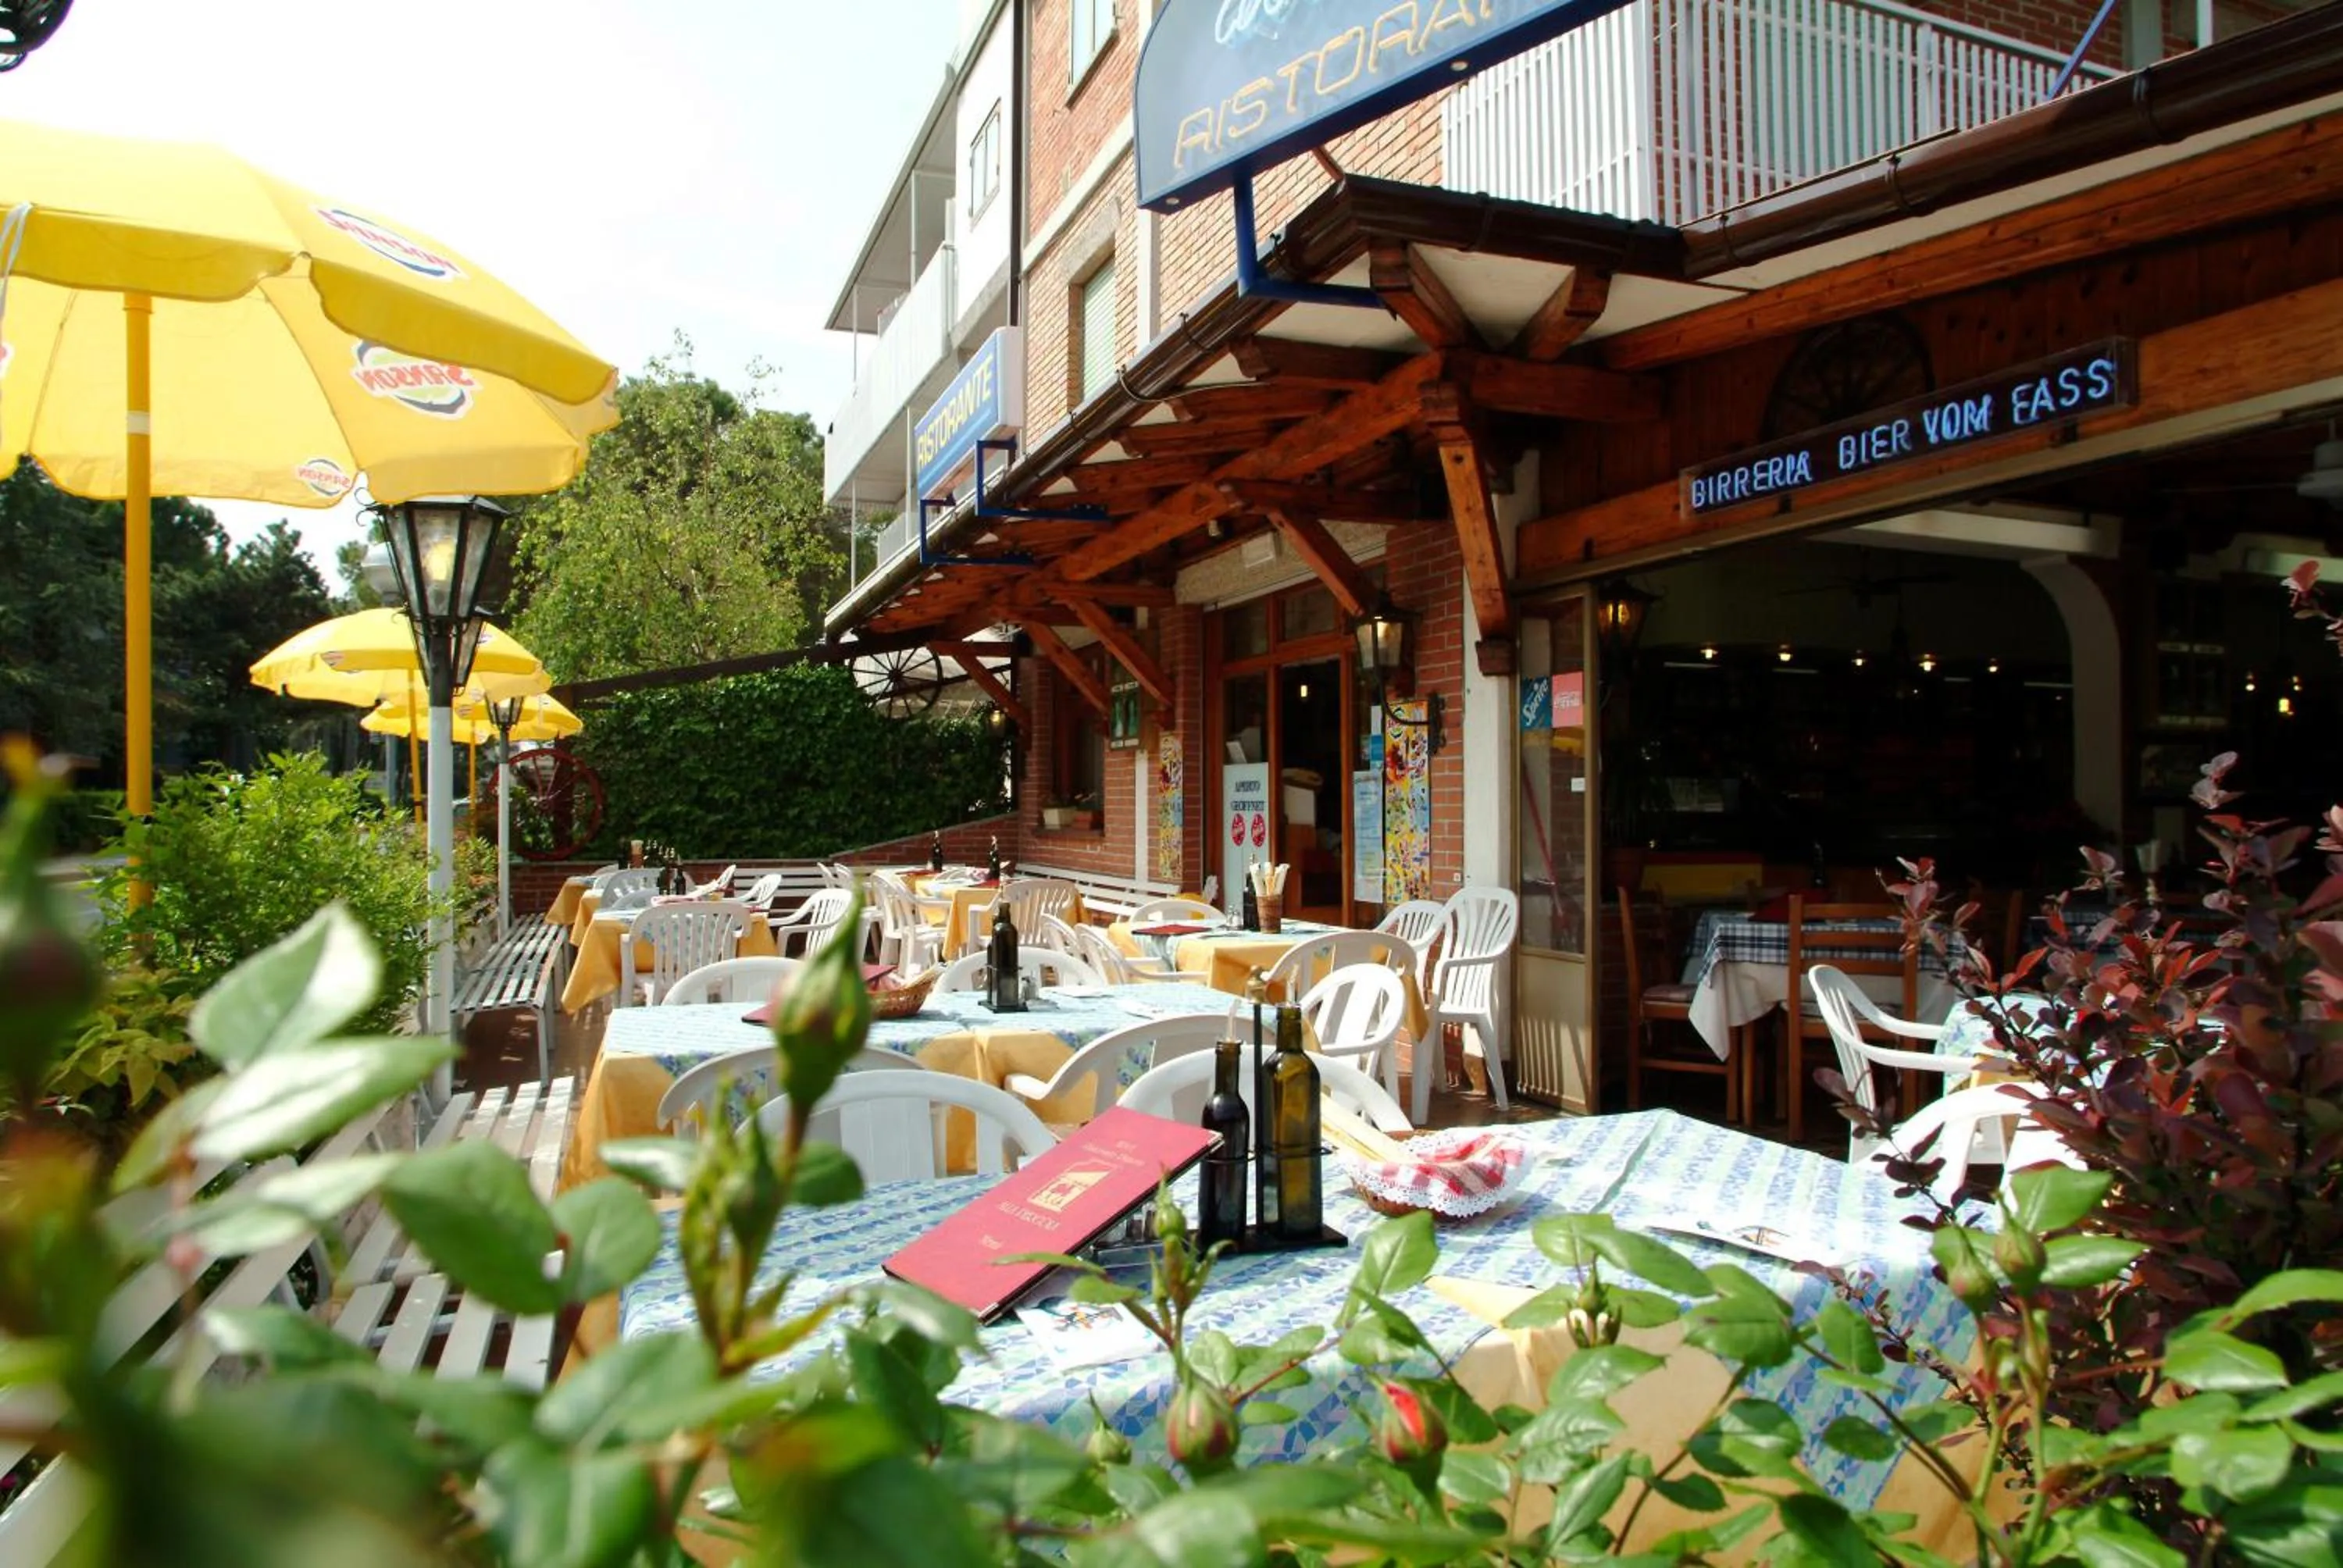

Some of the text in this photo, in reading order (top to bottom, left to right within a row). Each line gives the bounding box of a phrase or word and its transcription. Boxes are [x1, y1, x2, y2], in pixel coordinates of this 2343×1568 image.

[1173, 0, 1492, 166] RISTORA
[917, 353, 993, 469] RISTORANTE
[1691, 449, 1813, 509] BIRRERIA
[1838, 418, 1913, 470] BIER
[1922, 394, 1993, 445] VOM
